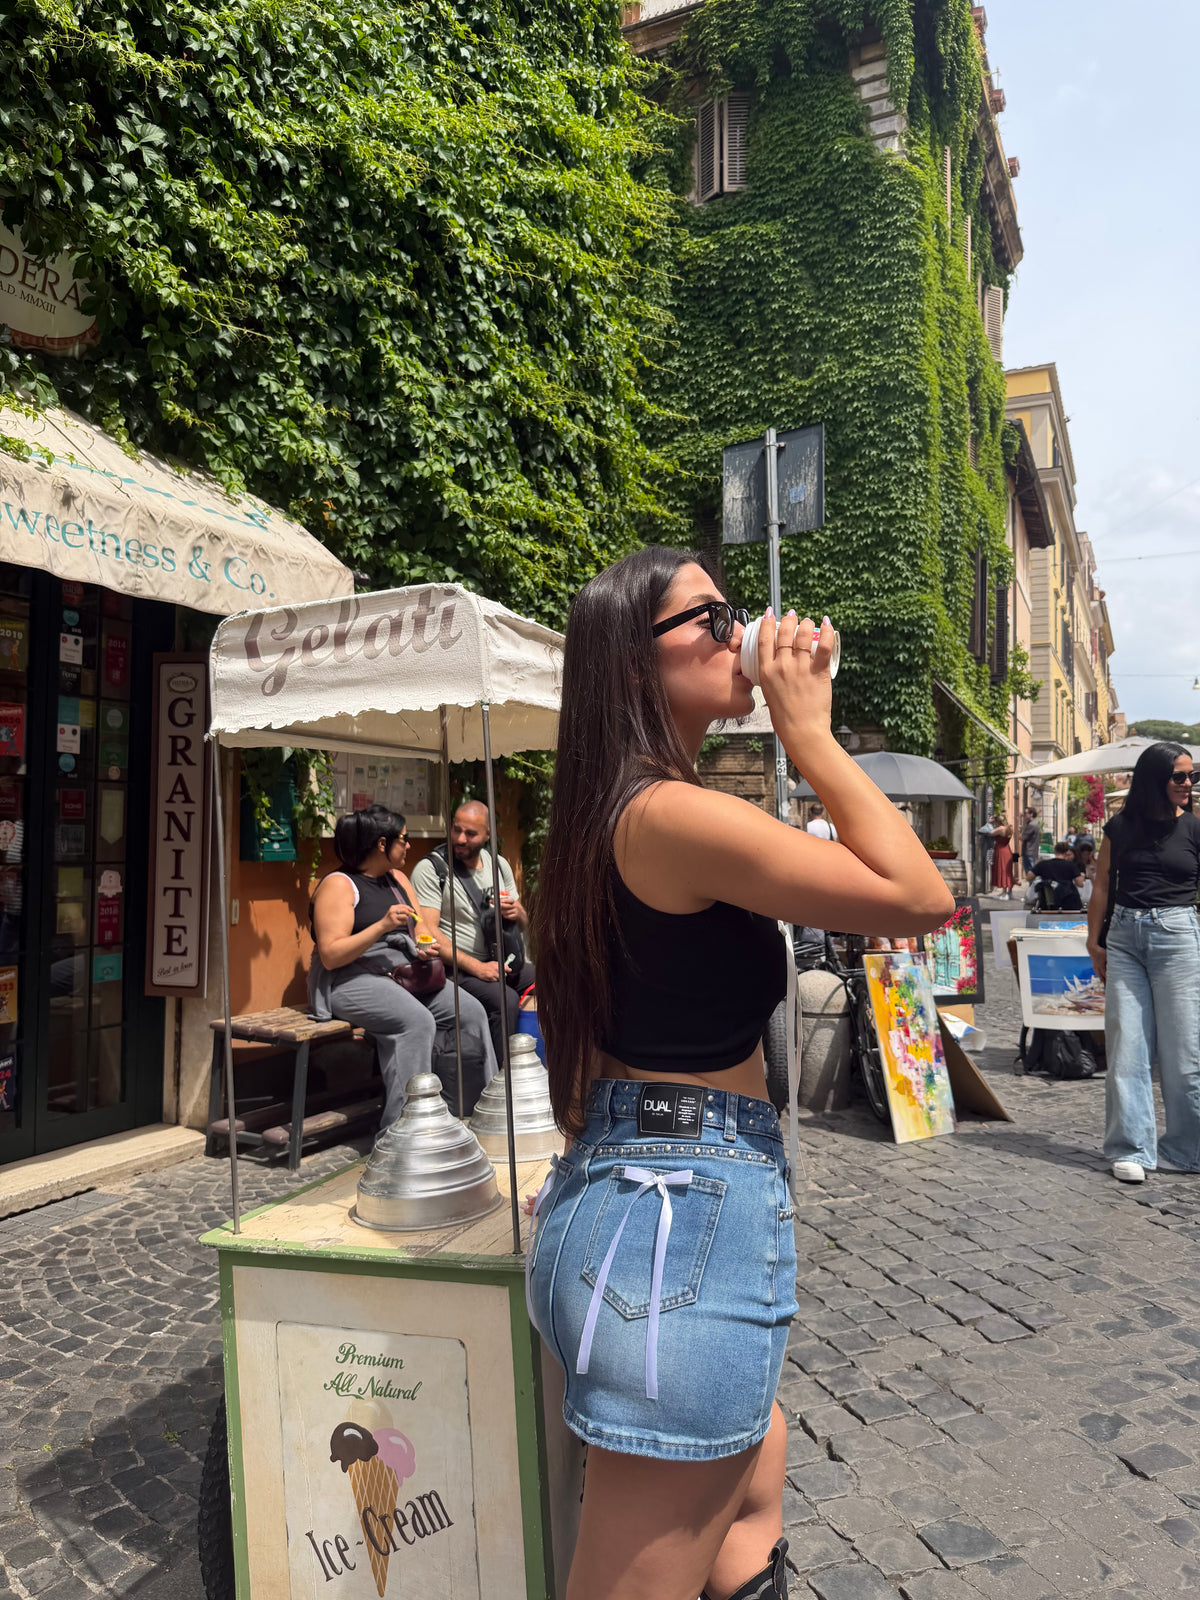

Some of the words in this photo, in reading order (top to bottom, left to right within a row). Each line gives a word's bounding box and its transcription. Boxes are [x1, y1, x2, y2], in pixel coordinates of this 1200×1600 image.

[20, 290, 57, 314] MMXIII
[0, 502, 176, 572] weetness
[188, 545, 211, 582] &
[224, 557, 275, 598] Co.
[244, 588, 463, 697] Gelati
[163, 697, 197, 957] GRANITE
[643, 1099, 672, 1113] DUAL
[336, 1342, 405, 1370] Premium
[324, 1371, 365, 1400] All
[358, 1376, 422, 1400] Natural
